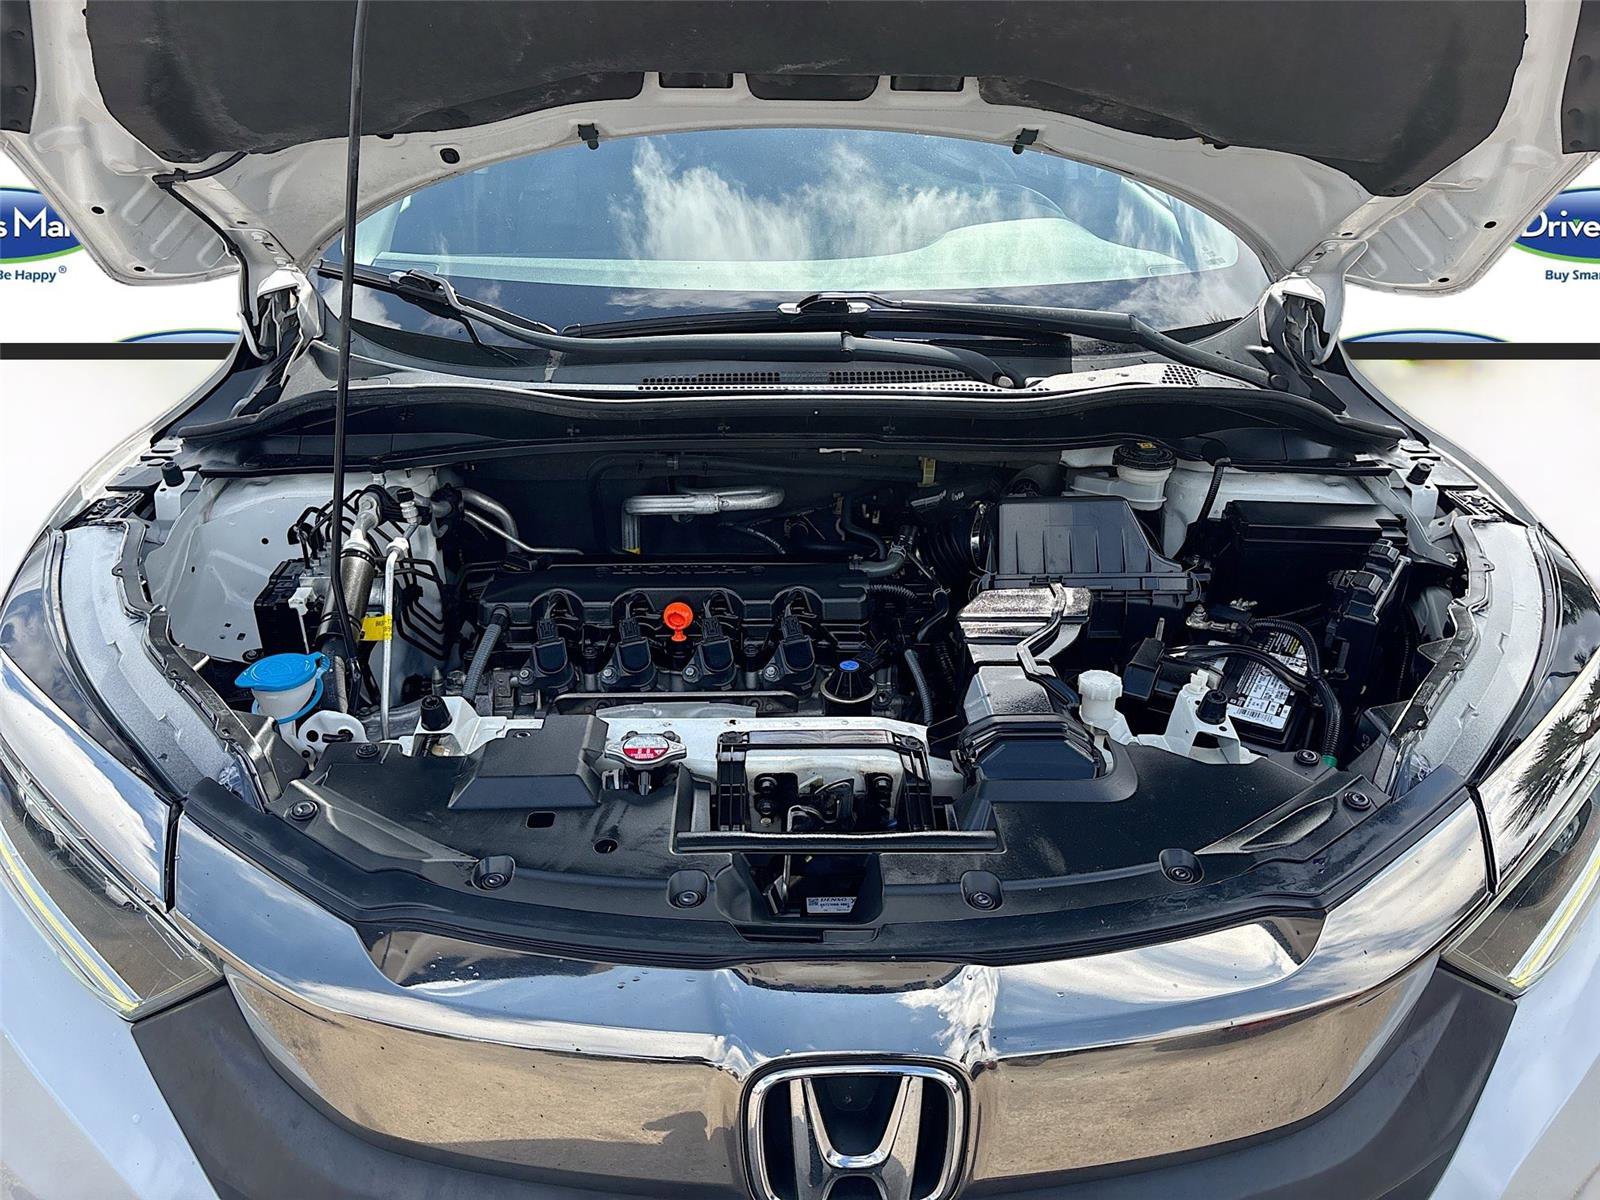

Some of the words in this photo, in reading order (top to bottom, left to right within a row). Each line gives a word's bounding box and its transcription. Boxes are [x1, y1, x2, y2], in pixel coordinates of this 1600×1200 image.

[15, 270, 57, 283] Happy
[1545, 269, 1570, 283] Buy
[1572, 269, 1600, 280] Sma
